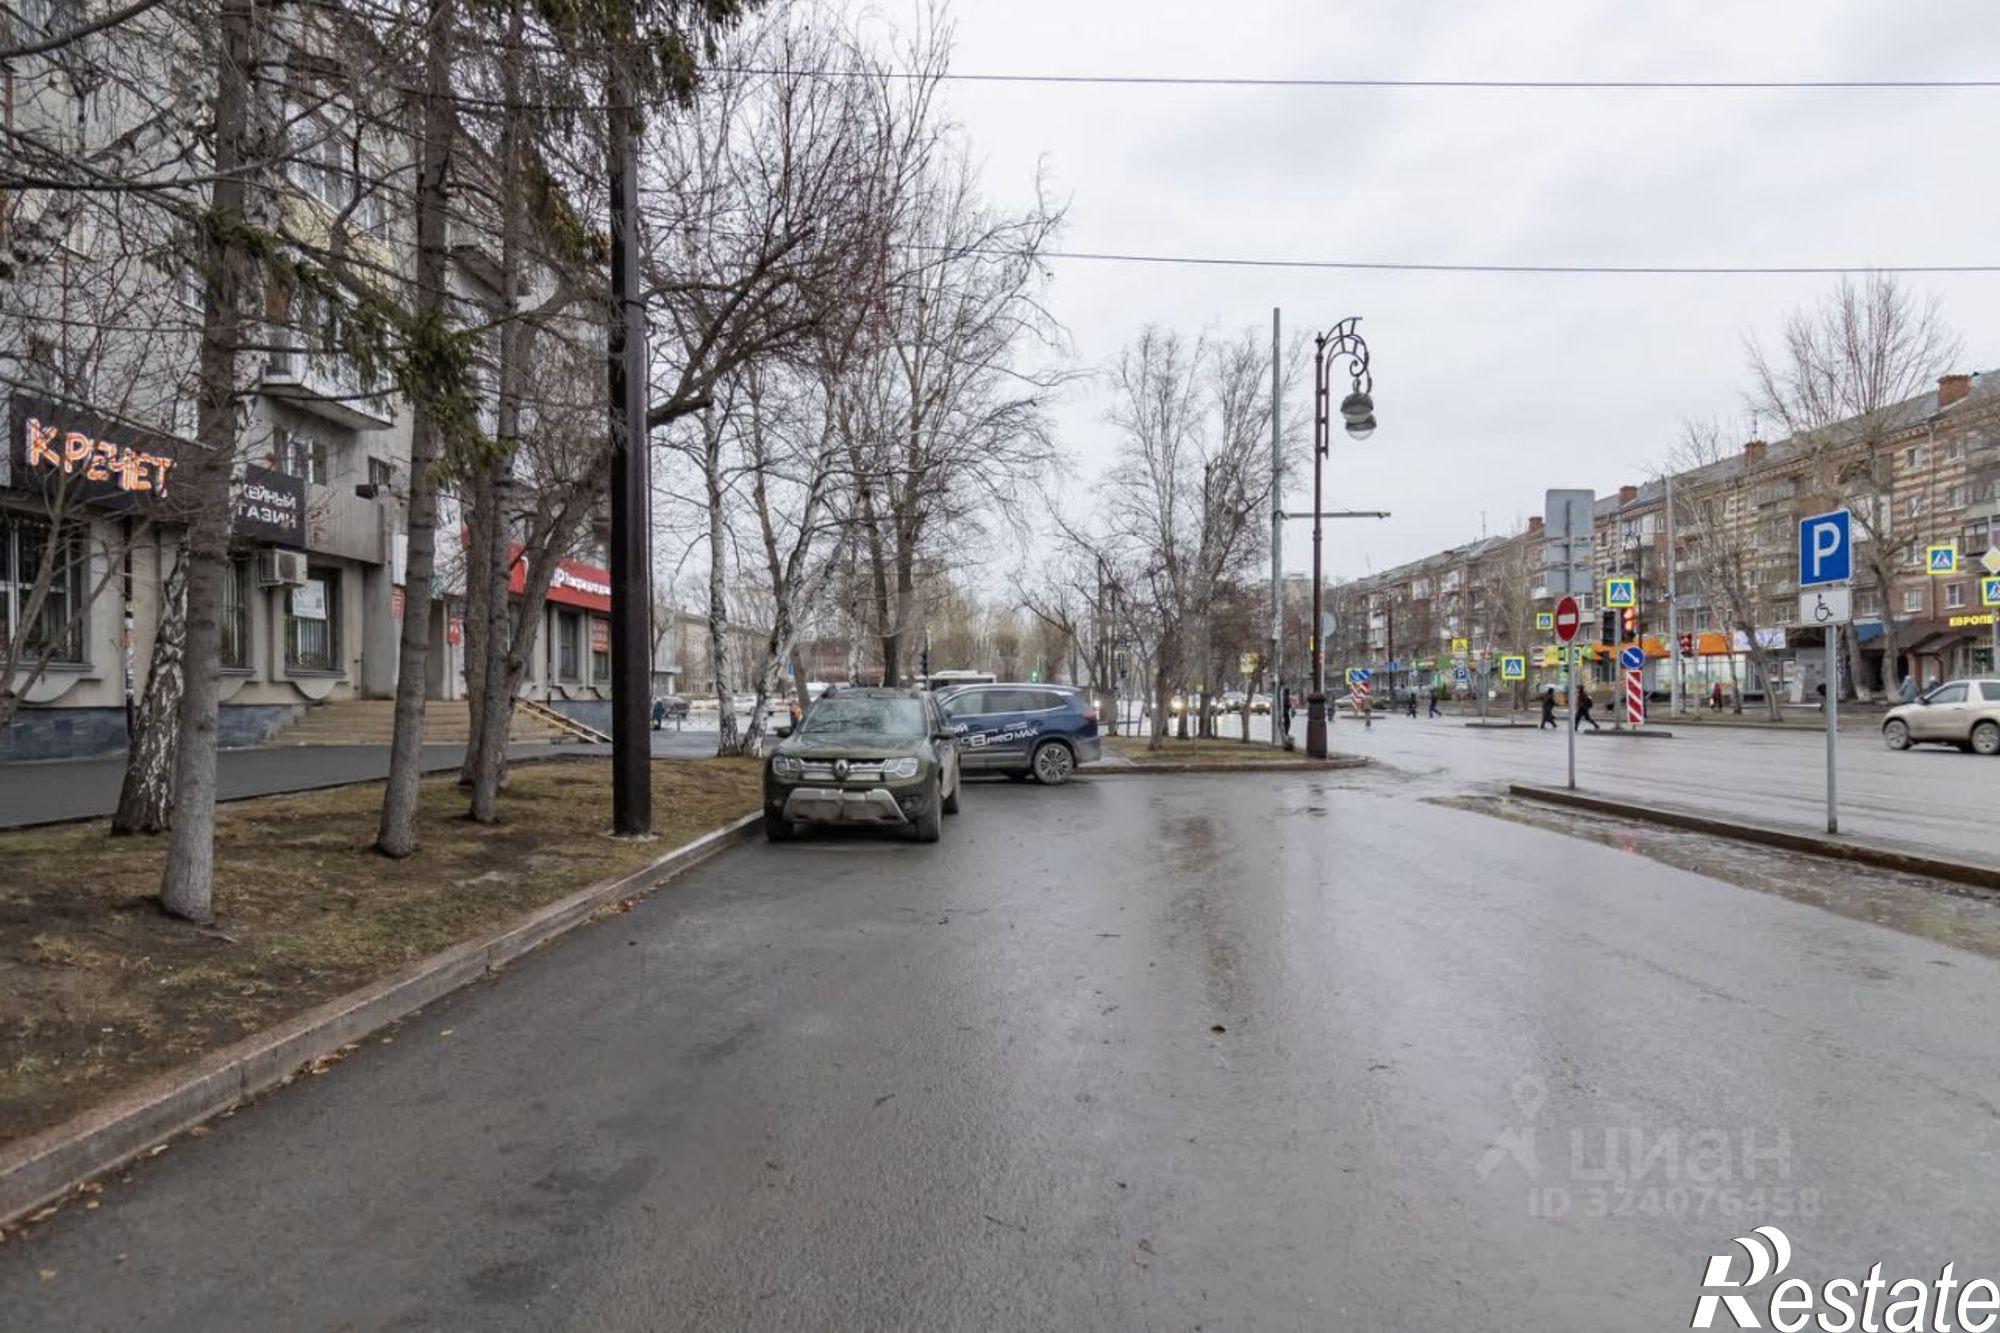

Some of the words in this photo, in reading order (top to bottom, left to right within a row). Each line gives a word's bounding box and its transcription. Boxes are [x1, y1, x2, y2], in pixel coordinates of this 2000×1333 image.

[1813, 522, 1841, 577] P
[987, 732, 1014, 745] PRO
[1014, 727, 1040, 739] MAX
